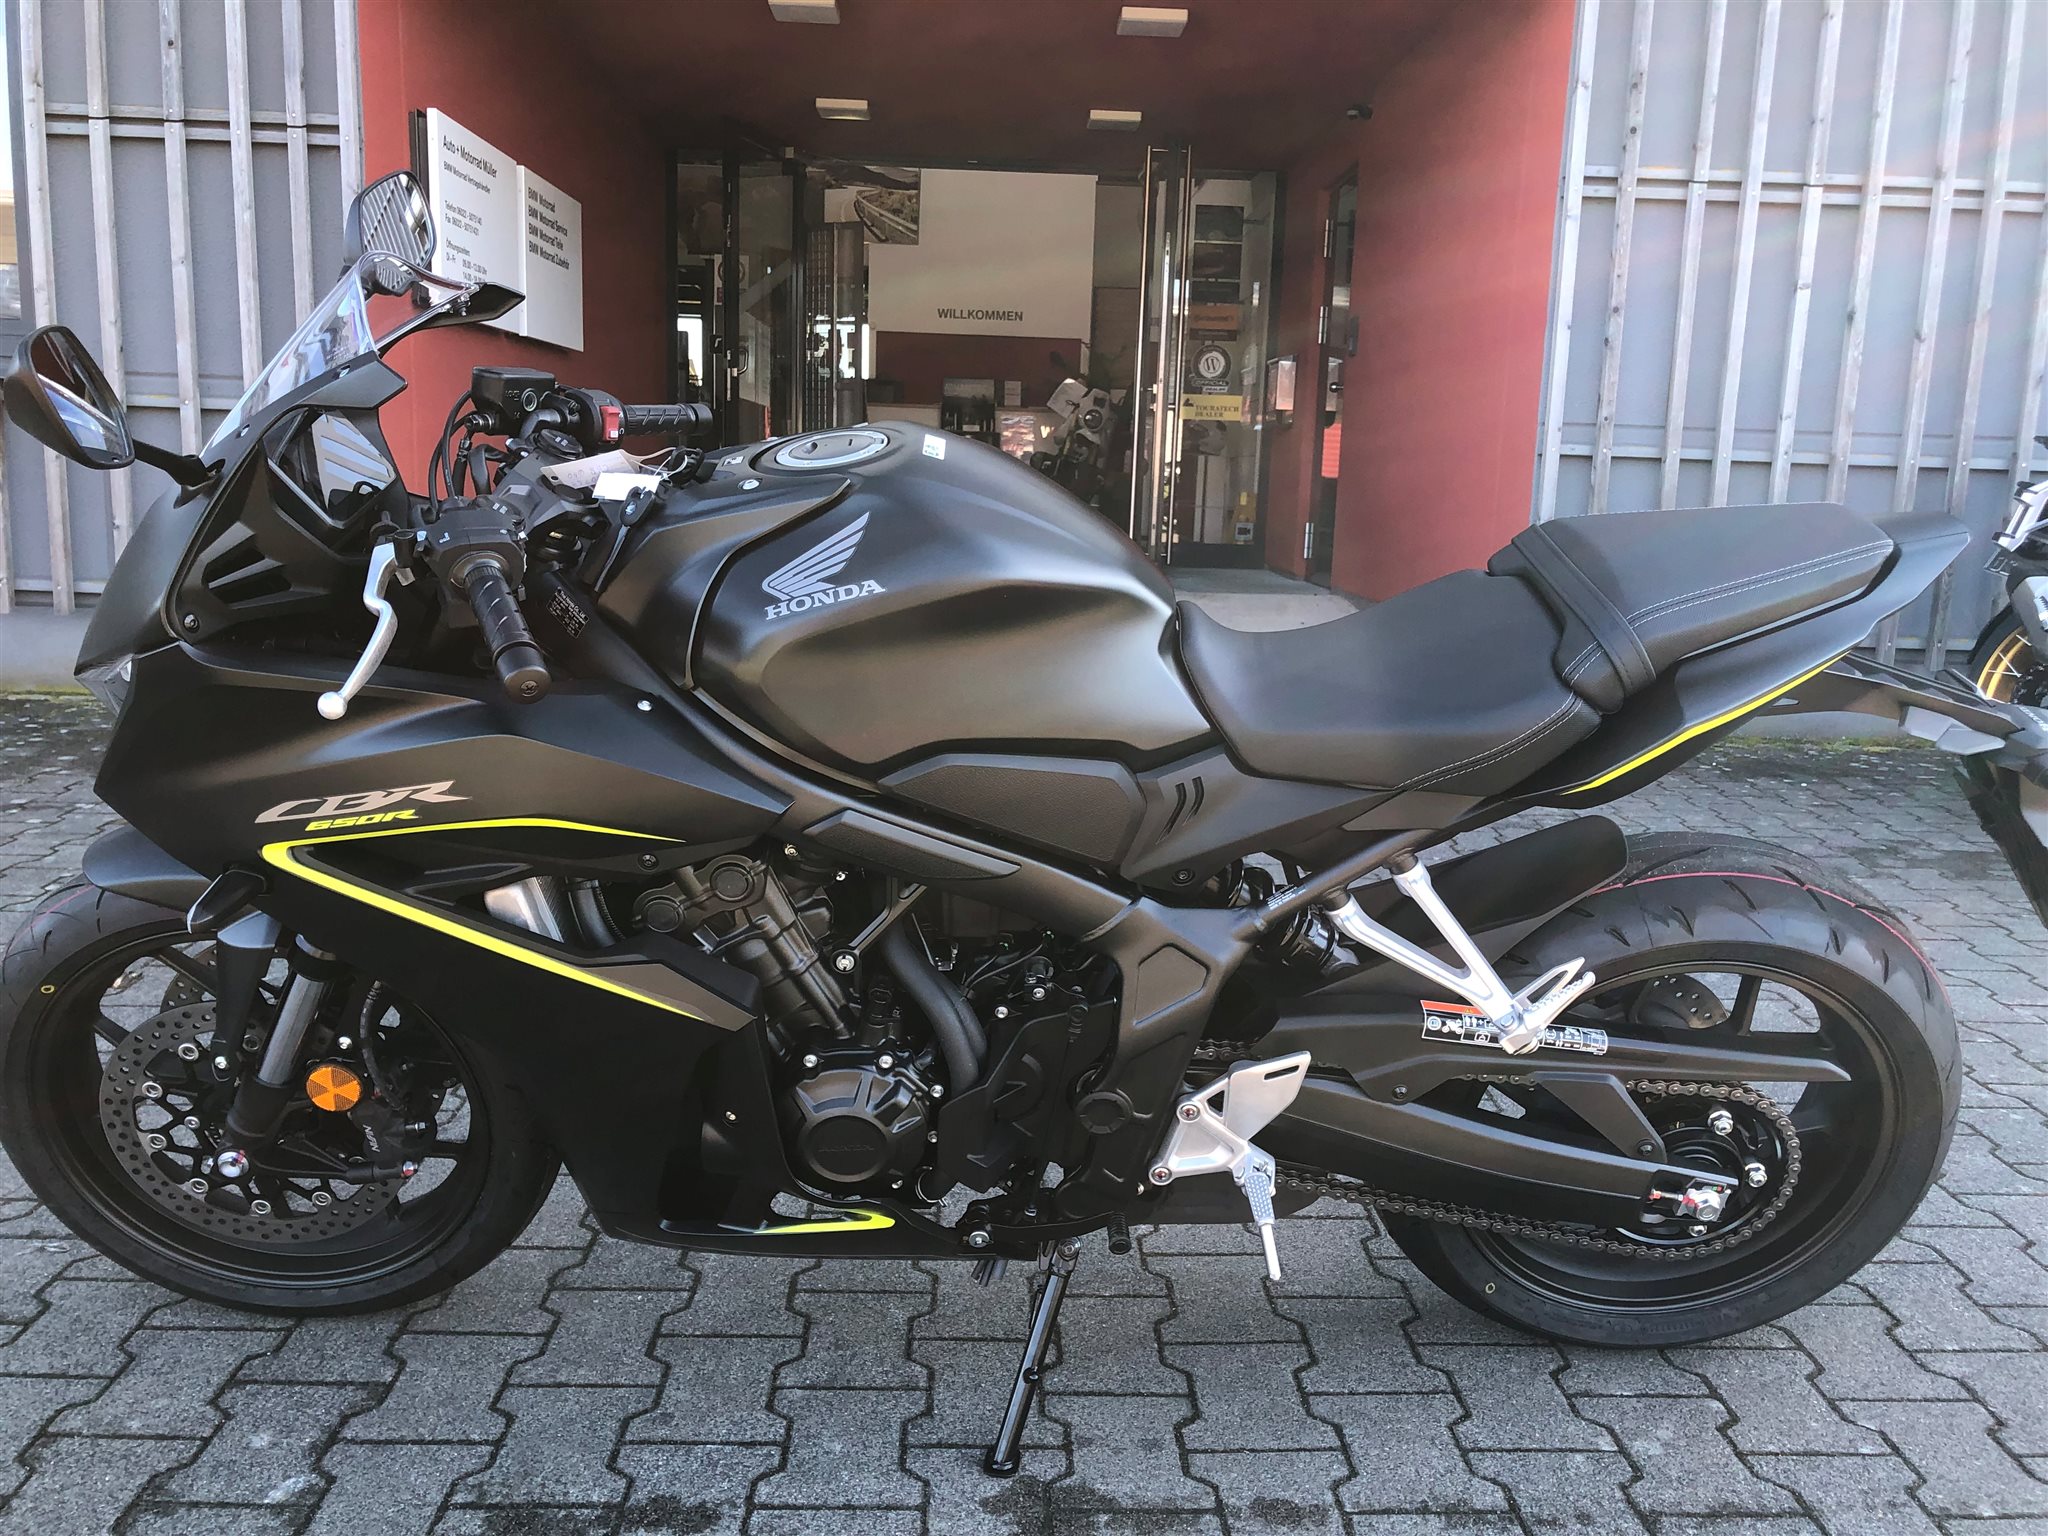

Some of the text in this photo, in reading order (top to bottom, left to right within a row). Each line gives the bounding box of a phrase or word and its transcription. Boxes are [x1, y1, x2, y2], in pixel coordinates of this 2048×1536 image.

[443, 135, 455, 154] Auto
[460, 145, 482, 170] Motorrad
[482, 157, 497, 178] Müller
[443, 160, 452, 173] BMW
[452, 165, 468, 181] Motorrad
[528, 186, 555, 213] BMW Motorrad
[528, 204, 568, 237] BMW Motorrad Service
[528, 222, 538, 238] BMW
[539, 228, 555, 247] Motorrad
[529, 240, 539, 256] BMW
[540, 246, 555, 264] Motorrad
[937, 308, 1023, 321] WILLKOMMEN
[764, 579, 886, 620] HONDA
[255, 780, 472, 823] CBR
[305, 809, 421, 831] 650R
